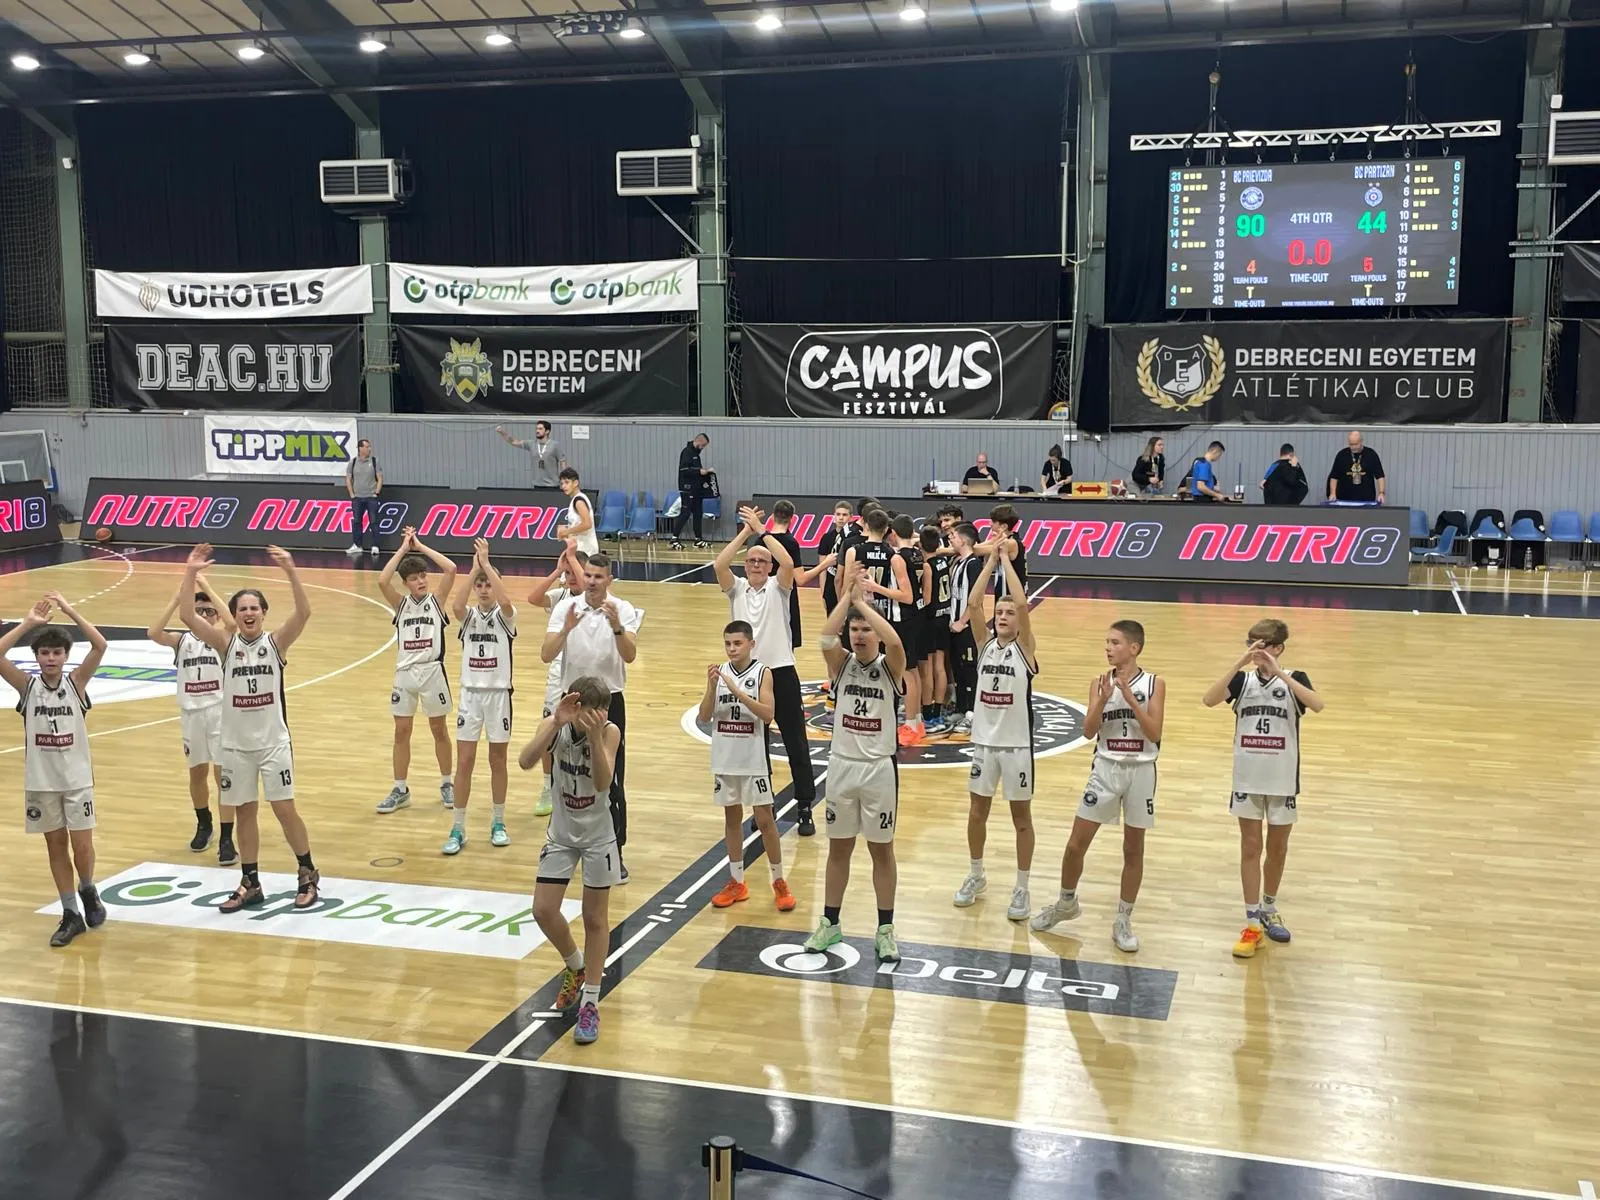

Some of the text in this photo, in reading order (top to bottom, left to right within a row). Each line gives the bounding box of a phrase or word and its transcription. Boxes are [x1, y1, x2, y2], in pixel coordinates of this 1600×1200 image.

[1405, 163, 1410, 172] 1
[1454, 161, 1460, 170] 6
[1171, 172, 1181, 180] 21
[1221, 170, 1226, 179] 1
[1364, 165, 1395, 178] PARTIZAN
[1404, 175, 1410, 184] 4
[1454, 173, 1460, 182] 6
[1170, 183, 1181, 192] 30
[1220, 182, 1226, 190] 2
[1453, 186, 1460, 194] 2
[1404, 187, 1410, 196] 6
[1174, 195, 1180, 203] 2
[1220, 193, 1226, 202] 5
[1453, 198, 1459, 206] 4
[1403, 199, 1409, 208] 8
[1220, 205, 1225, 213] 7
[1452, 209, 1458, 218] 6
[1219, 216, 1224, 225] 8
[1290, 212, 1332, 224] 4TH QTR
[1400, 211, 1409, 220] 10
[1173, 218, 1179, 226] 5
[1236, 214, 1265, 238] 90
[1357, 211, 1387, 234] 44
[1400, 222, 1408, 231] 11
[1451, 221, 1457, 230] 3
[1170, 229, 1179, 238] 14
[1218, 228, 1224, 236] 9
[1215, 239, 1224, 248] 13
[1399, 234, 1408, 243] 13
[1172, 240, 1178, 248] 4
[1215, 250, 1224, 259] 19
[1288, 239, 1332, 266] 0.0
[1398, 246, 1407, 255] 14
[1214, 262, 1224, 270] 24
[1363, 256, 1373, 272] 5
[1397, 258, 1407, 267] 15
[1450, 257, 1456, 266] 4
[1172, 263, 1177, 271] 2
[1246, 260, 1256, 274] 4
[1213, 273, 1224, 282] 30
[1290, 273, 1329, 283] TIME-OUT
[1397, 270, 1407, 279] 16
[1449, 268, 1456, 278] 2
[582, 272, 682, 306] otpbank
[1171, 285, 1176, 294] 4
[1213, 284, 1223, 293] 31
[1396, 281, 1406, 290] 17
[1446, 280, 1455, 289] 11
[168, 280, 324, 308] UDHOTELS
[434, 278, 529, 306] otpbank
[1246, 286, 1254, 298] T
[1364, 284, 1372, 297] T
[1170, 297, 1176, 305] 3
[1212, 296, 1224, 305] 45
[1352, 298, 1384, 306] TIME-OUTS
[1395, 293, 1406, 303] 37
[502, 349, 642, 373] DEBRECENI
[1235, 348, 1476, 367] DEBRECENI EGYETEM
[136, 344, 333, 392] DEAC.HU
[800, 340, 992, 392] CAMPUS
[1176, 360, 1188, 382] E
[502, 376, 586, 394] EGYETEM
[1232, 373, 1474, 399] ATLÉTIKAI CLUB
[843, 398, 946, 415] FESZTIVÁL
[87, 494, 240, 530] NUTRI8
[1178, 523, 1400, 565] NUTRI8
[415, 626, 420, 638] 9
[479, 644, 484, 657] 8
[247, 678, 257, 694] 13
[993, 677, 999, 691] 2
[439, 692, 446, 704] 9
[730, 705, 740, 720] 19
[854, 699, 868, 716] 24
[503, 718, 509, 731] 8
[1122, 722, 1128, 737] 5
[1256, 718, 1270, 734] 45
[1244, 738, 1282, 747] PARTNERS
[280, 769, 291, 786] 13
[1020, 772, 1027, 787] 2
[573, 780, 577, 795] 1
[756, 778, 768, 794] 19
[83, 802, 93, 817] 31
[1146, 798, 1153, 815] 5
[880, 811, 893, 829] 24
[605, 853, 611, 871] 1
